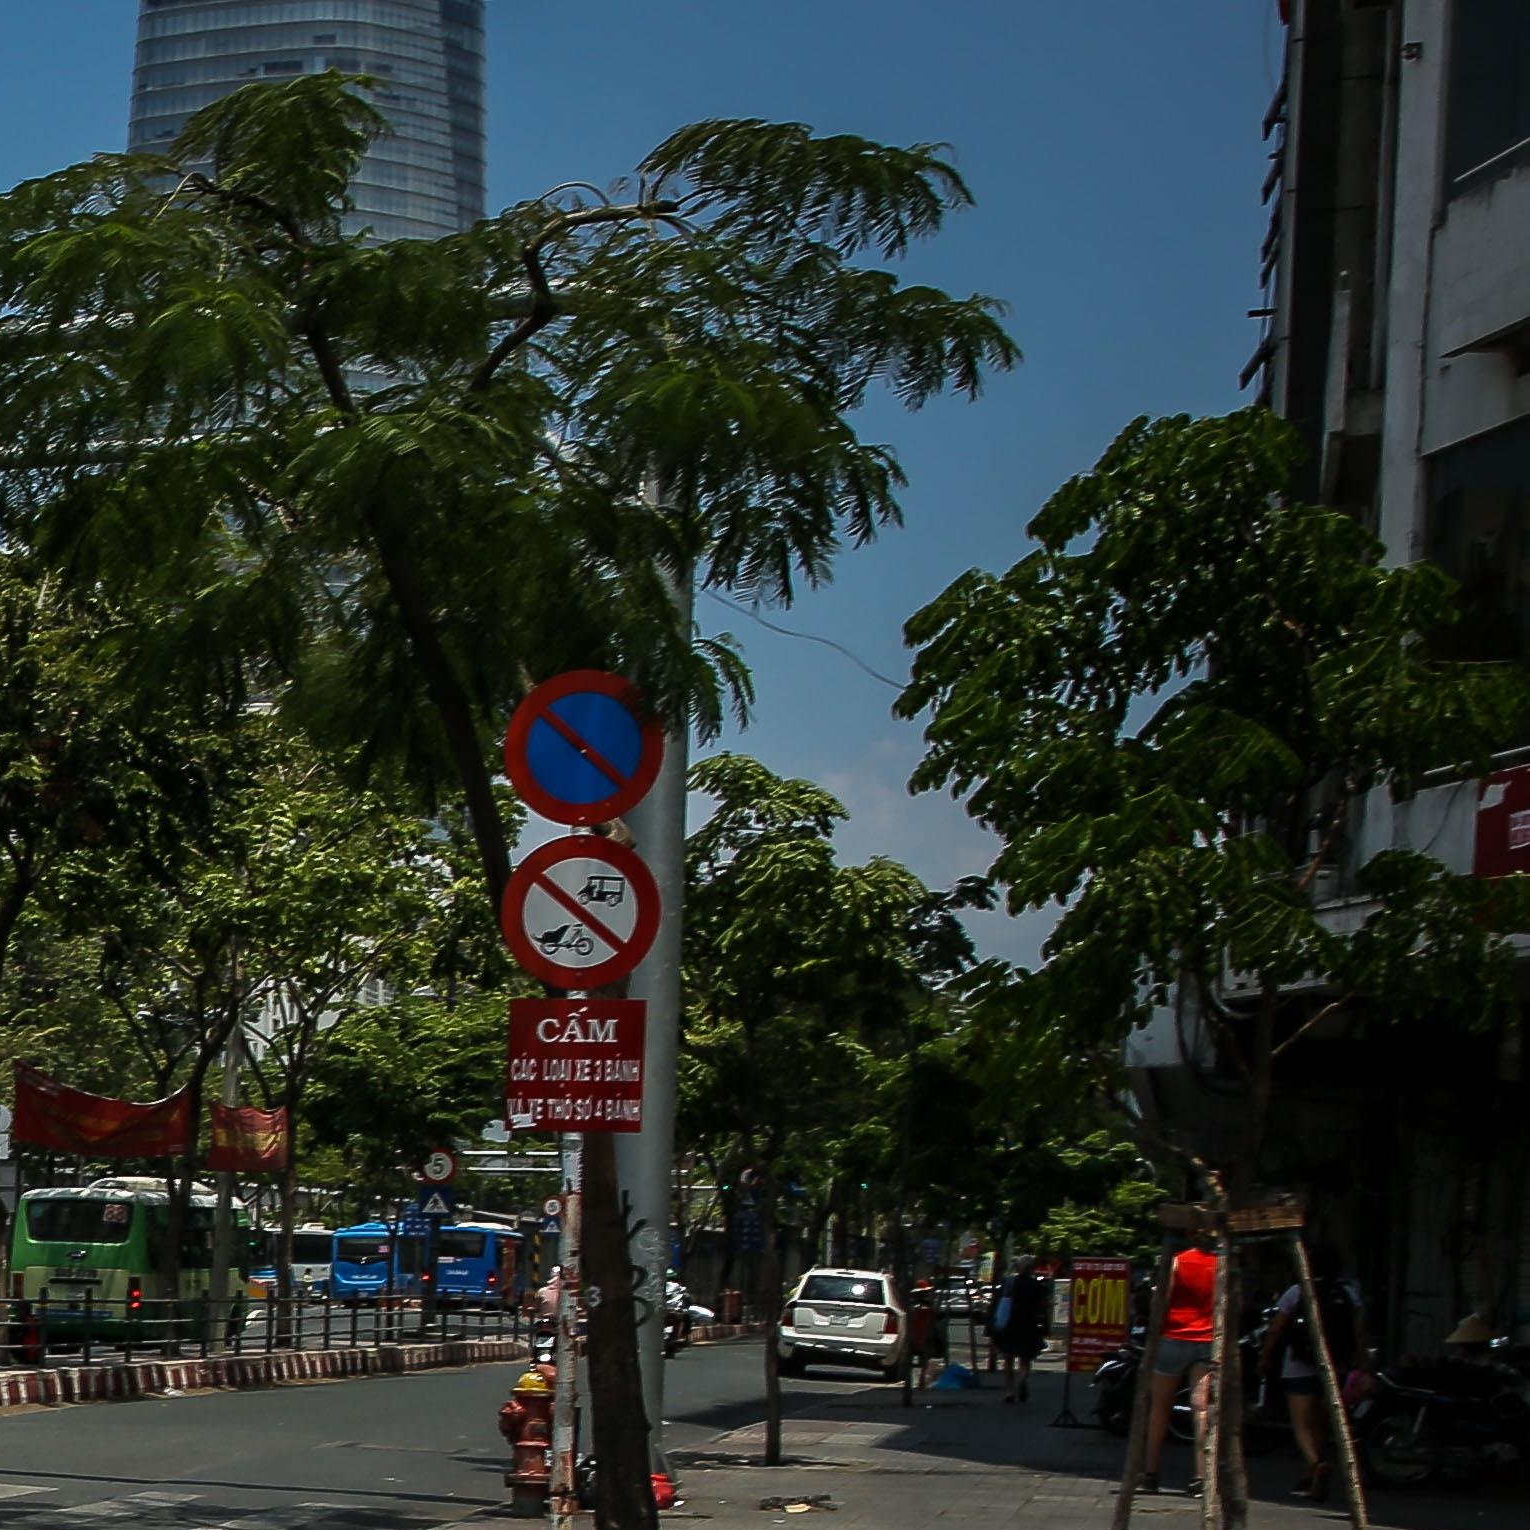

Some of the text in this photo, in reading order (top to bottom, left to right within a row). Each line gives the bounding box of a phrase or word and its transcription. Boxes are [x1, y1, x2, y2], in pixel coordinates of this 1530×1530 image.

[536, 1007, 619, 1043] CẤM
[510, 1052, 538, 1081] CÁC
[573, 1058, 591, 1082] XE
[594, 1058, 602, 1082] 3
[593, 1098, 603, 1117] 4
[432, 1157, 445, 1176] 5
[586, 1285, 603, 1308] 3
[1074, 1274, 1125, 1325] CƠM
